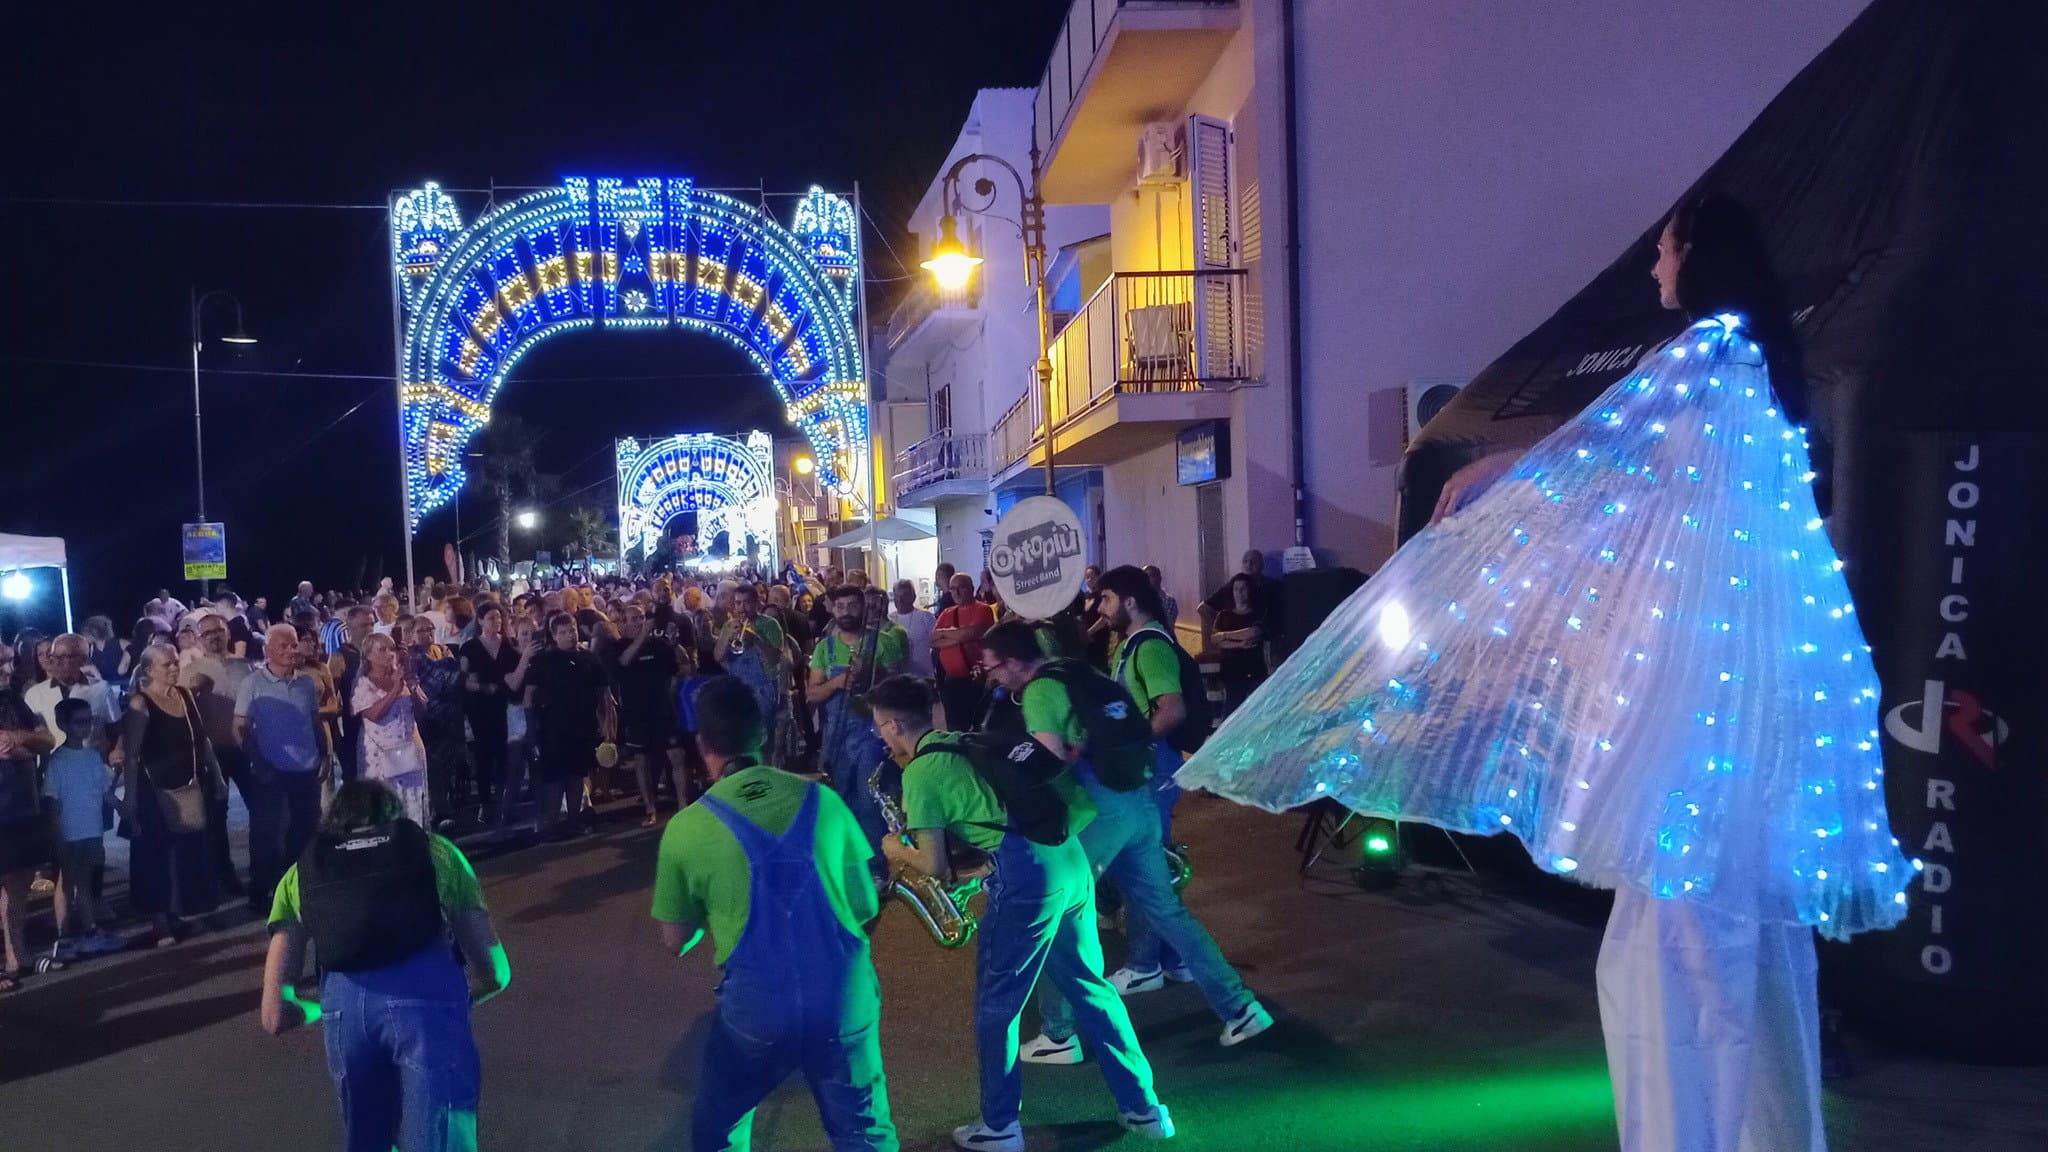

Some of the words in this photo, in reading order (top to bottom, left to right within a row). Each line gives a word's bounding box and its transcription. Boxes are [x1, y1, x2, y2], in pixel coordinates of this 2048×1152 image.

[1566, 345, 1642, 377] JONICA
[1015, 576, 1039, 591] Street
[1040, 568, 1060, 582] Band
[1935, 444, 1980, 660] JONICA
[1921, 778, 1956, 974] RADIO
